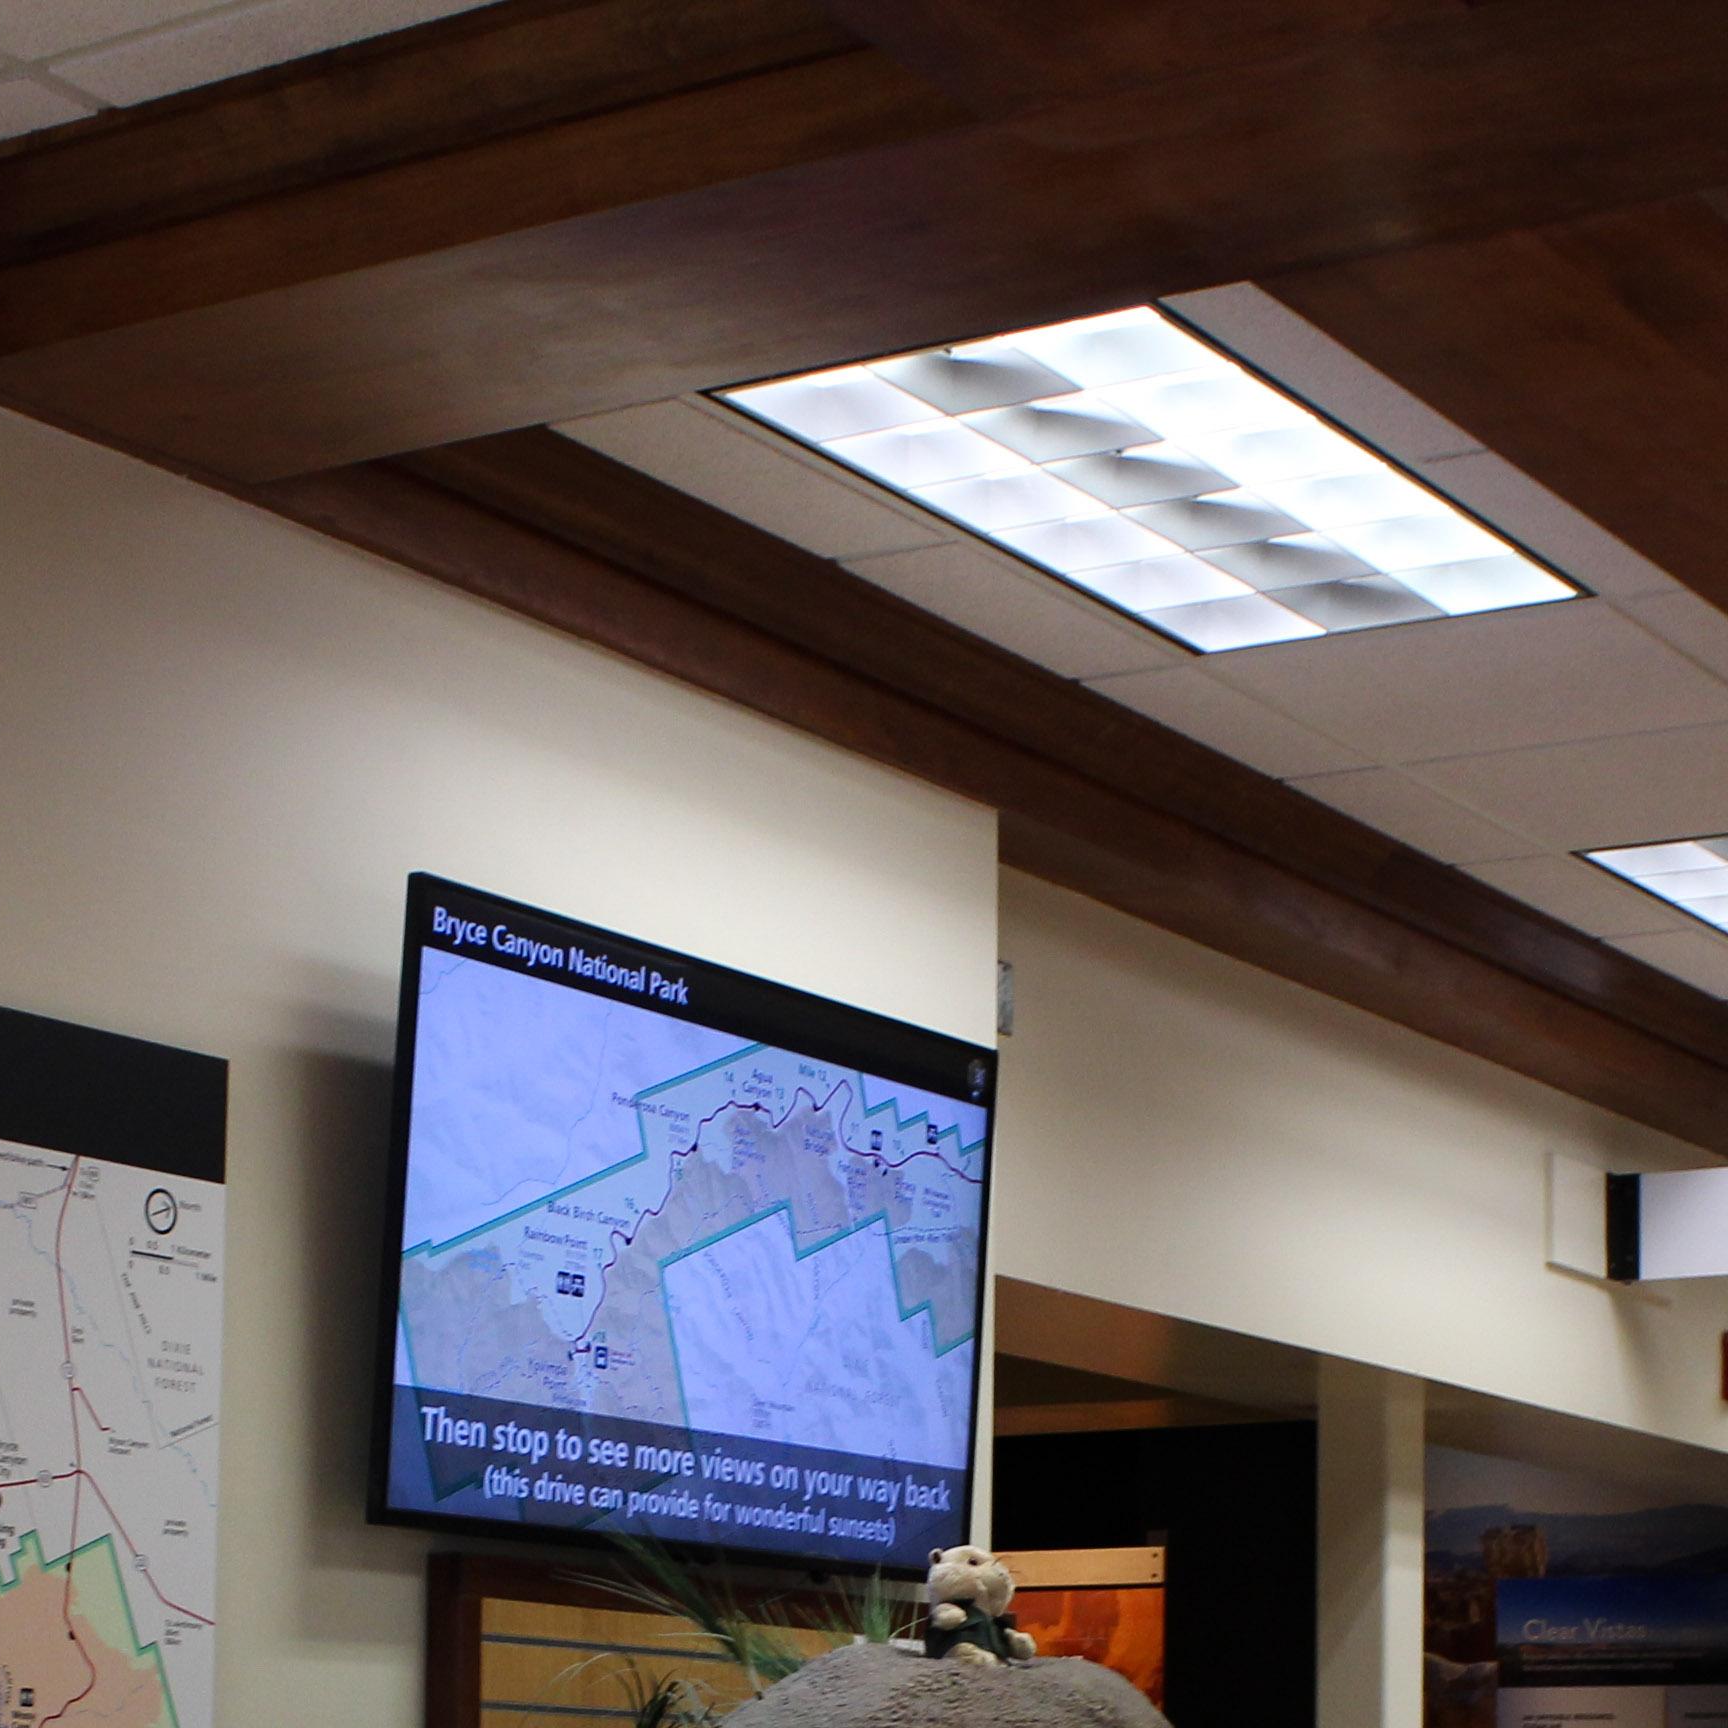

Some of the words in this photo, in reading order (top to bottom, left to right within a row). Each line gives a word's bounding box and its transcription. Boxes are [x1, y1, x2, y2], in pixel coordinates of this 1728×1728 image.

[432, 905, 487, 946] Bryce
[492, 925, 563, 967] Canyon
[568, 946, 645, 993] National
[649, 971, 689, 1006] Park
[421, 1405, 487, 1448] Then
[492, 1421, 550, 1464] stop
[556, 1428, 582, 1461] to
[587, 1438, 629, 1468] see
[634, 1444, 696, 1478] more
[700, 1447, 766, 1486] views
[771, 1464, 799, 1491] on
[802, 1468, 854, 1501] your
[856, 1475, 902, 1513] way
[904, 1474, 951, 1512] back
[483, 1464, 530, 1499] (this
[533, 1472, 586, 1506] drive
[589, 1486, 622, 1511] can
[626, 1489, 699, 1520] provide
[702, 1491, 733, 1523] for
[734, 1502, 827, 1535] wonderful
[828, 1515, 897, 1548] sunsets)
